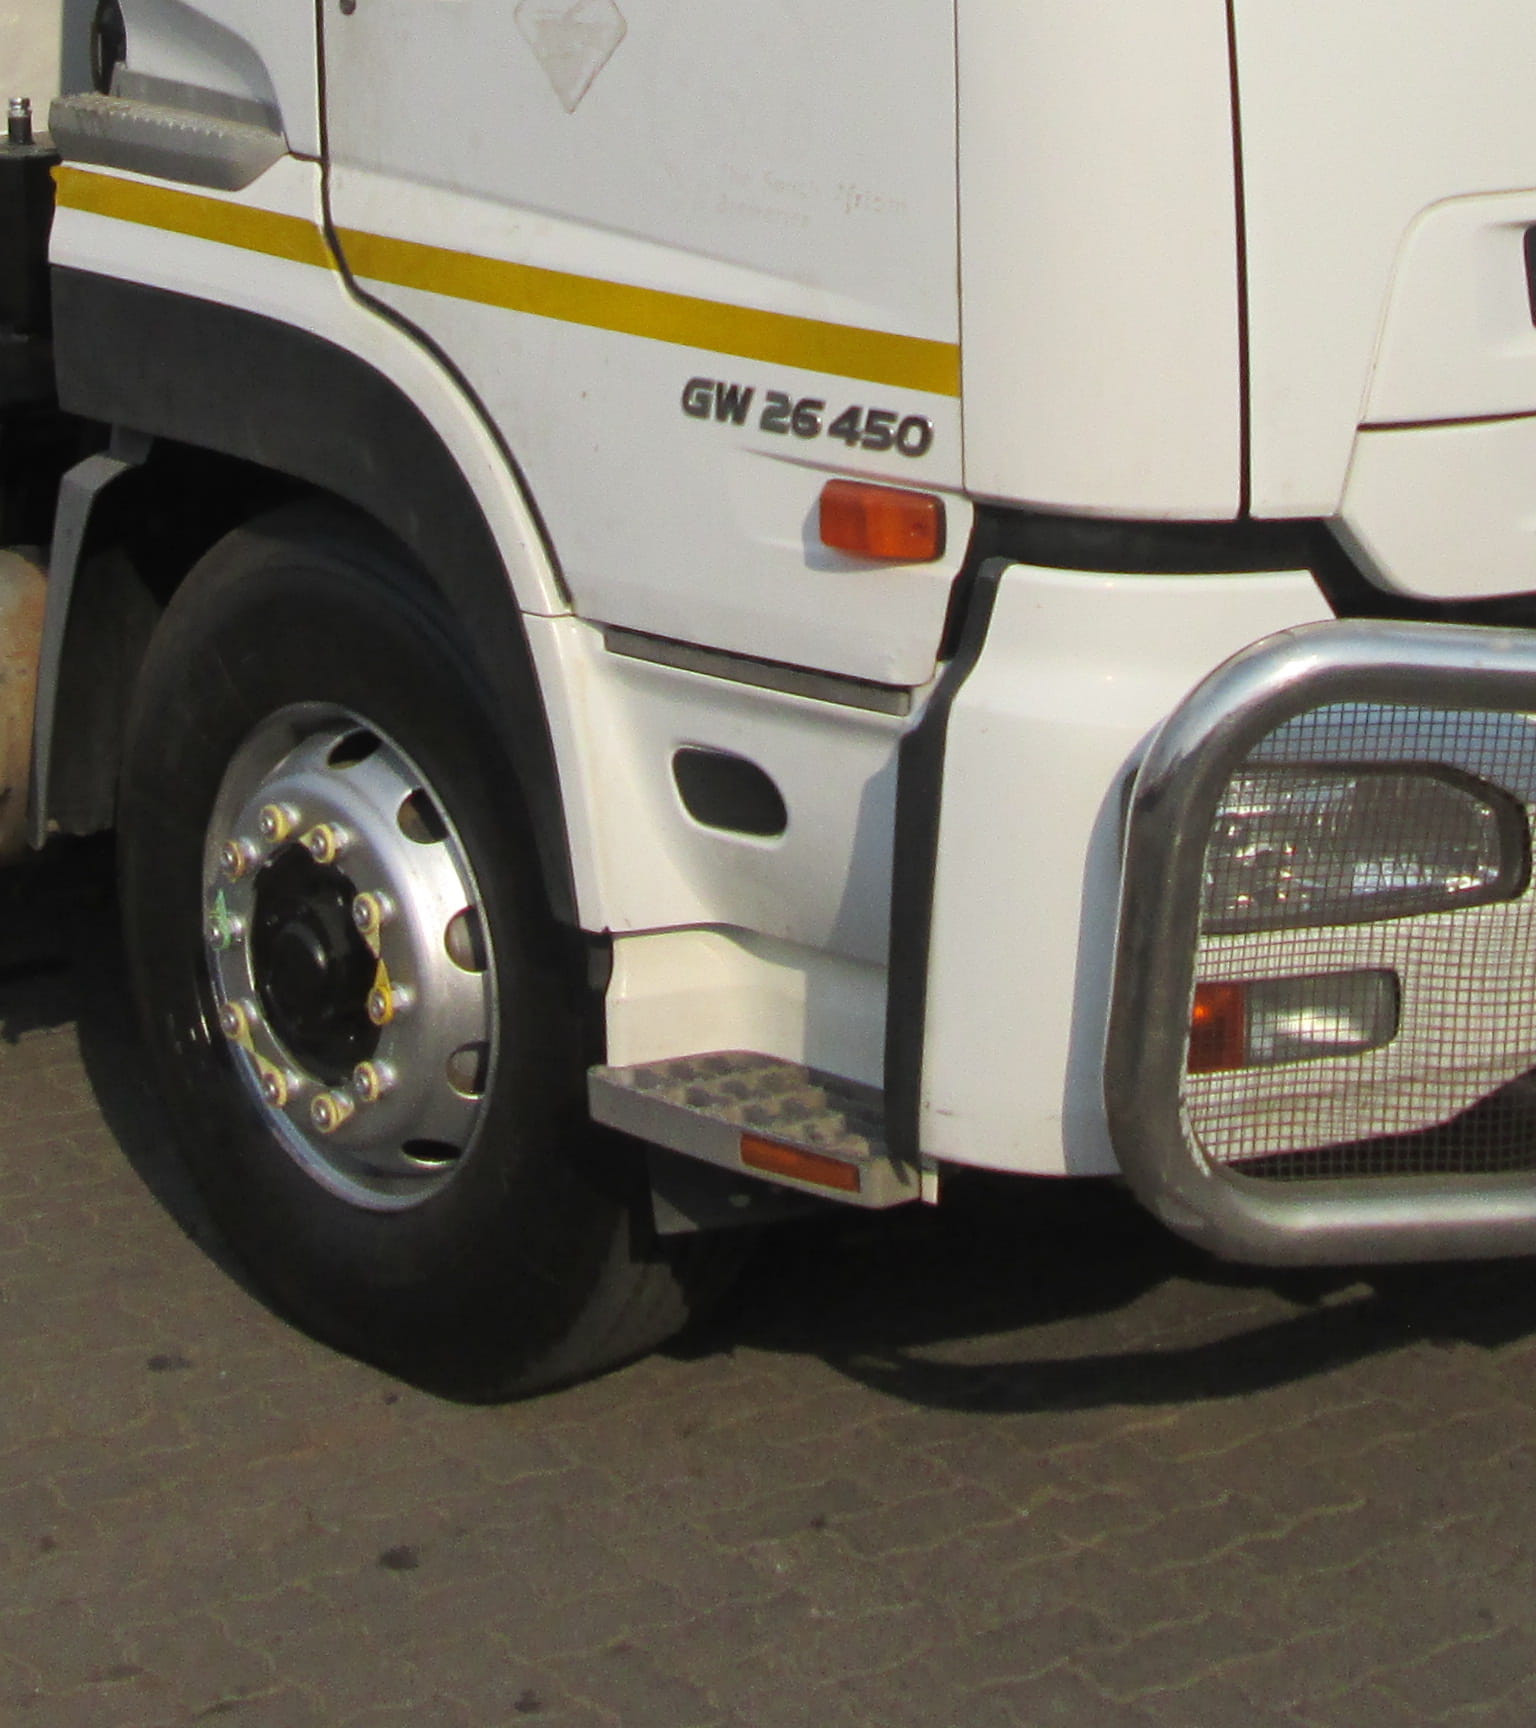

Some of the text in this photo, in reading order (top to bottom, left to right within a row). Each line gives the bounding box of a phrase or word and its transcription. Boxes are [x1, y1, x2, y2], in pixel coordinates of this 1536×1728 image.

[681, 376, 934, 458] GW 26 450
